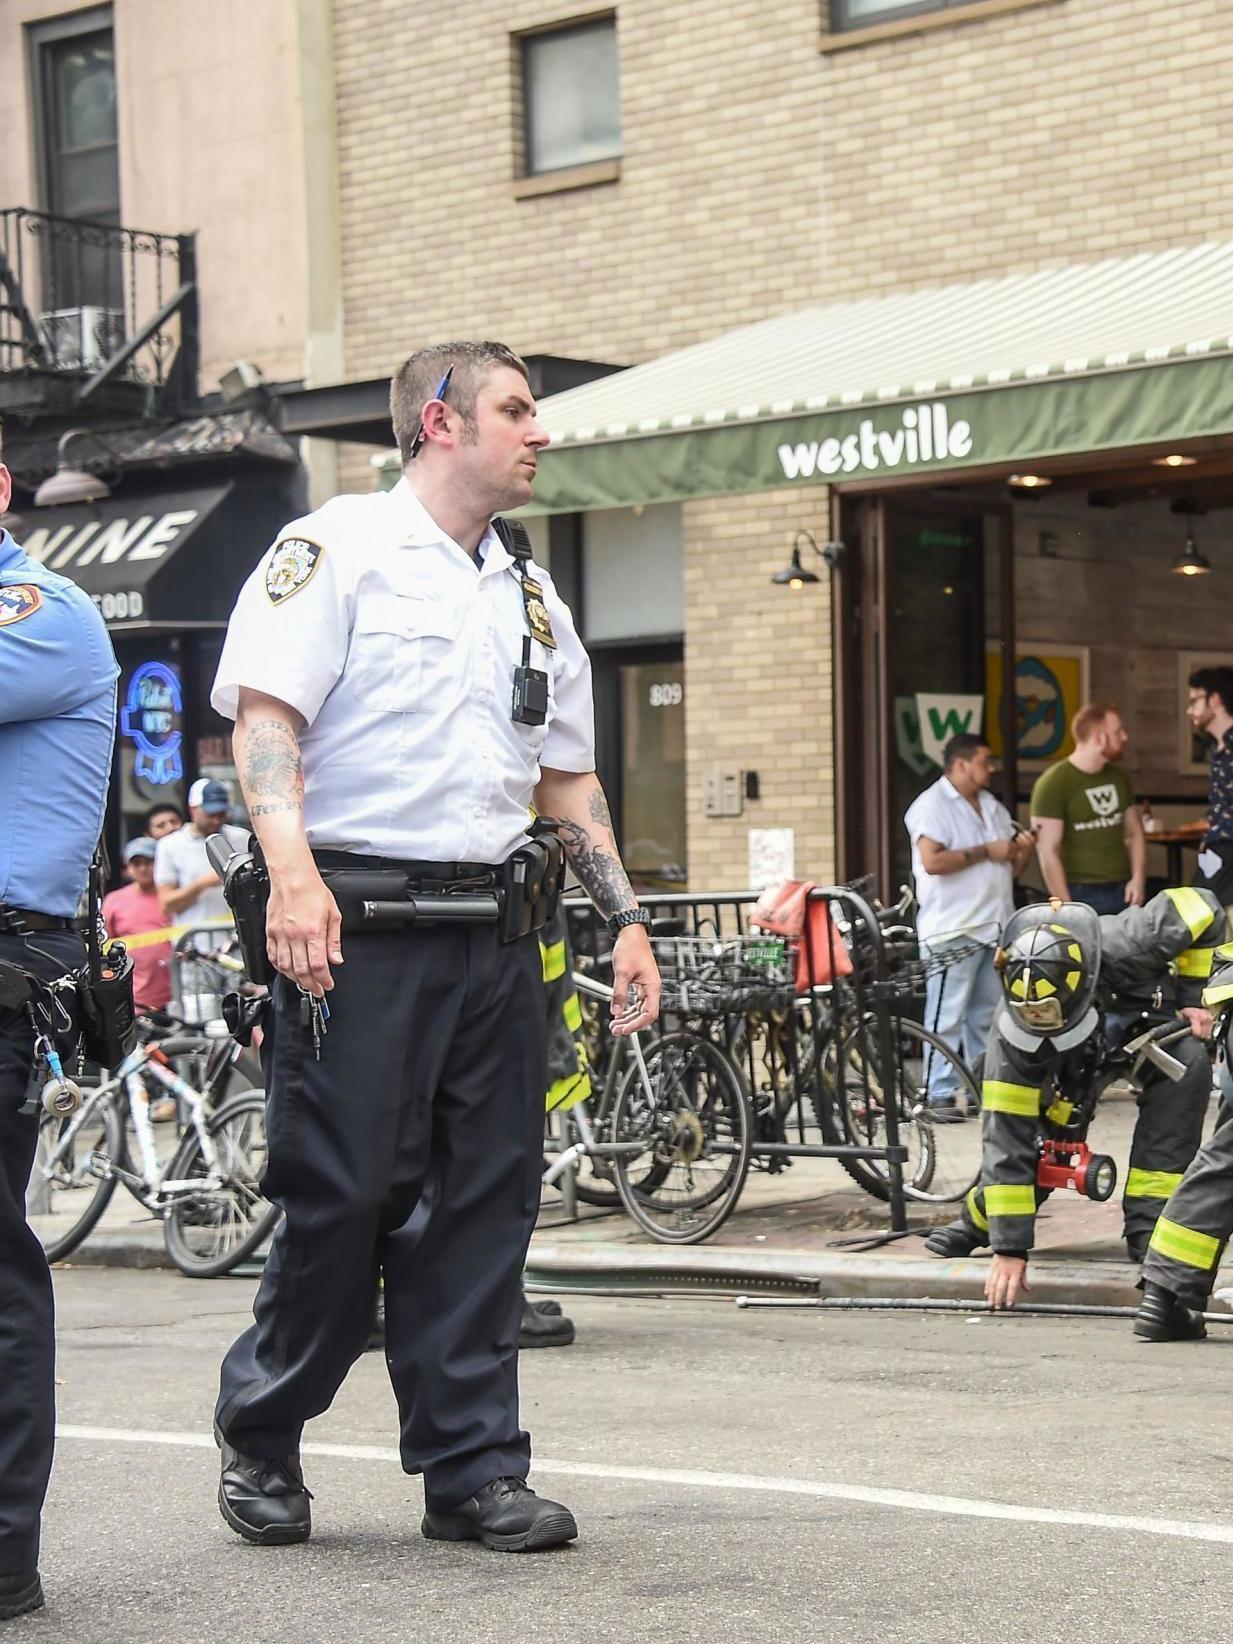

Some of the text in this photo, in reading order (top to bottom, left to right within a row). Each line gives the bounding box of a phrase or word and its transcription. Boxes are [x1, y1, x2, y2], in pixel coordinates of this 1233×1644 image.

[778, 402, 973, 479] westville
[649, 682, 682, 706] 809
[927, 707, 972, 741] W
[1093, 791, 1113, 805] W
